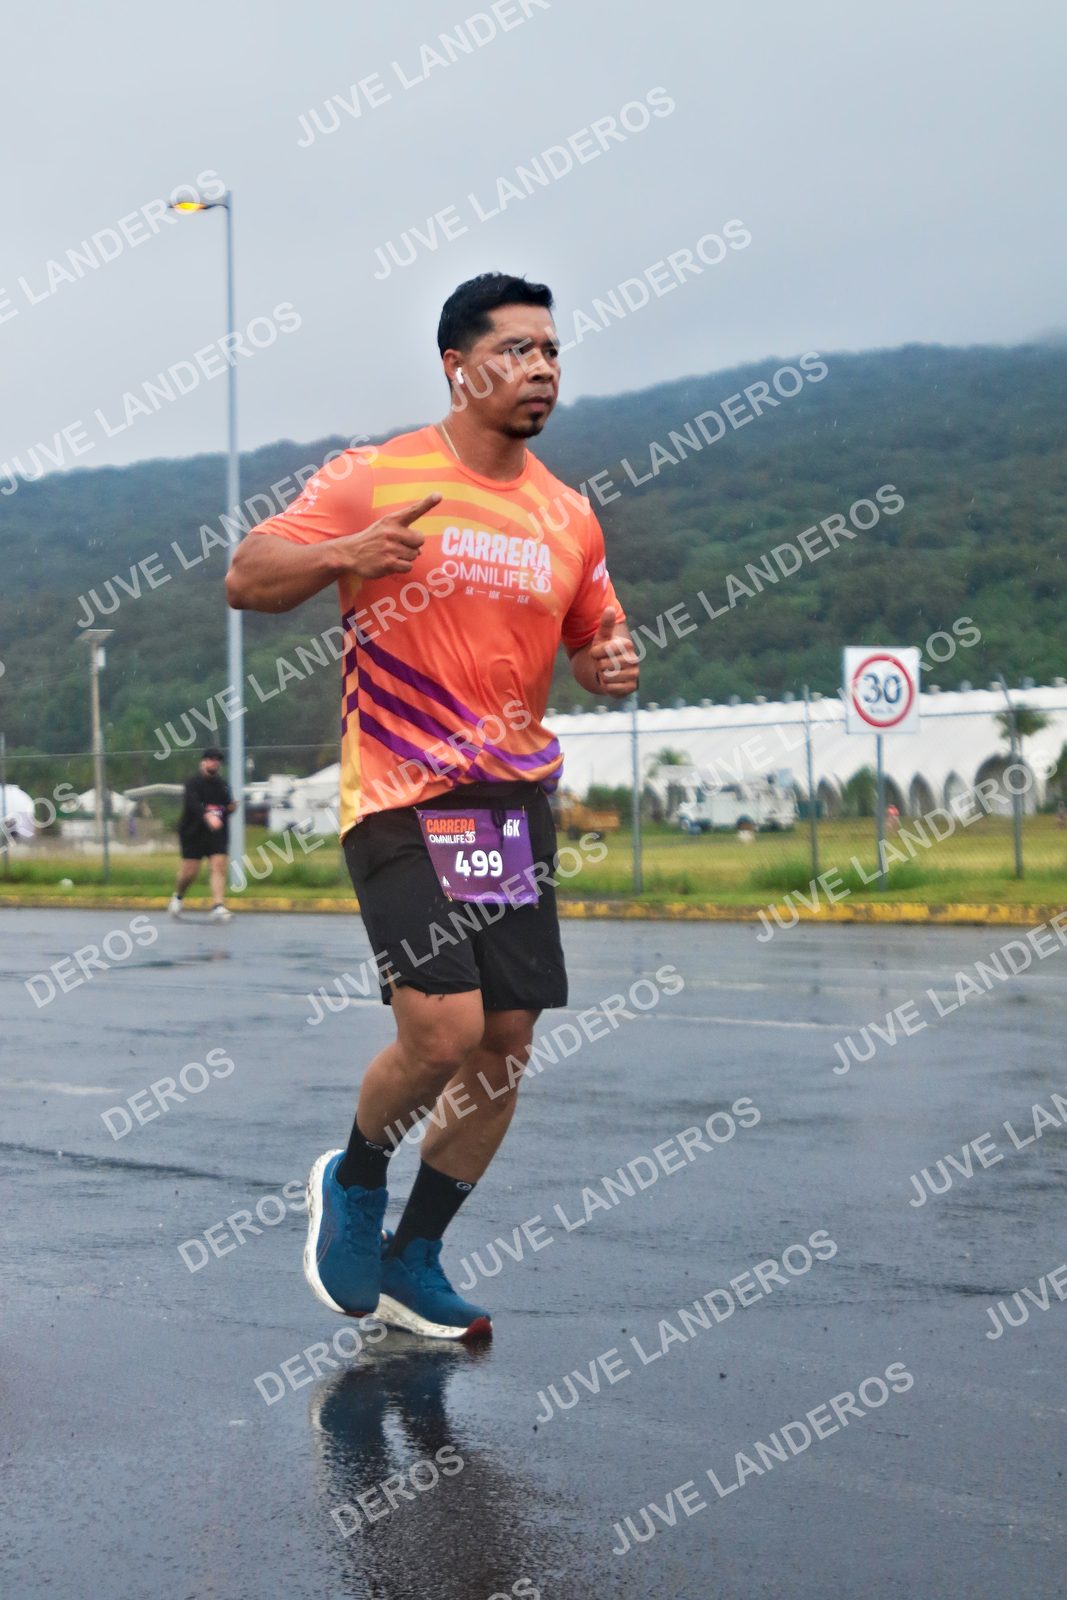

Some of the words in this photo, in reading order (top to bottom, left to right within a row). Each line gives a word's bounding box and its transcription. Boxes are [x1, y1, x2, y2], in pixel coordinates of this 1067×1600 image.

[441, 526, 552, 571] CARRERA
[441, 560, 531, 590] OMNILIFE
[863, 671, 901, 704] 30
[426, 818, 476, 833] CARRERA
[428, 834, 465, 844] OMNILIFE
[455, 850, 503, 877] 499
